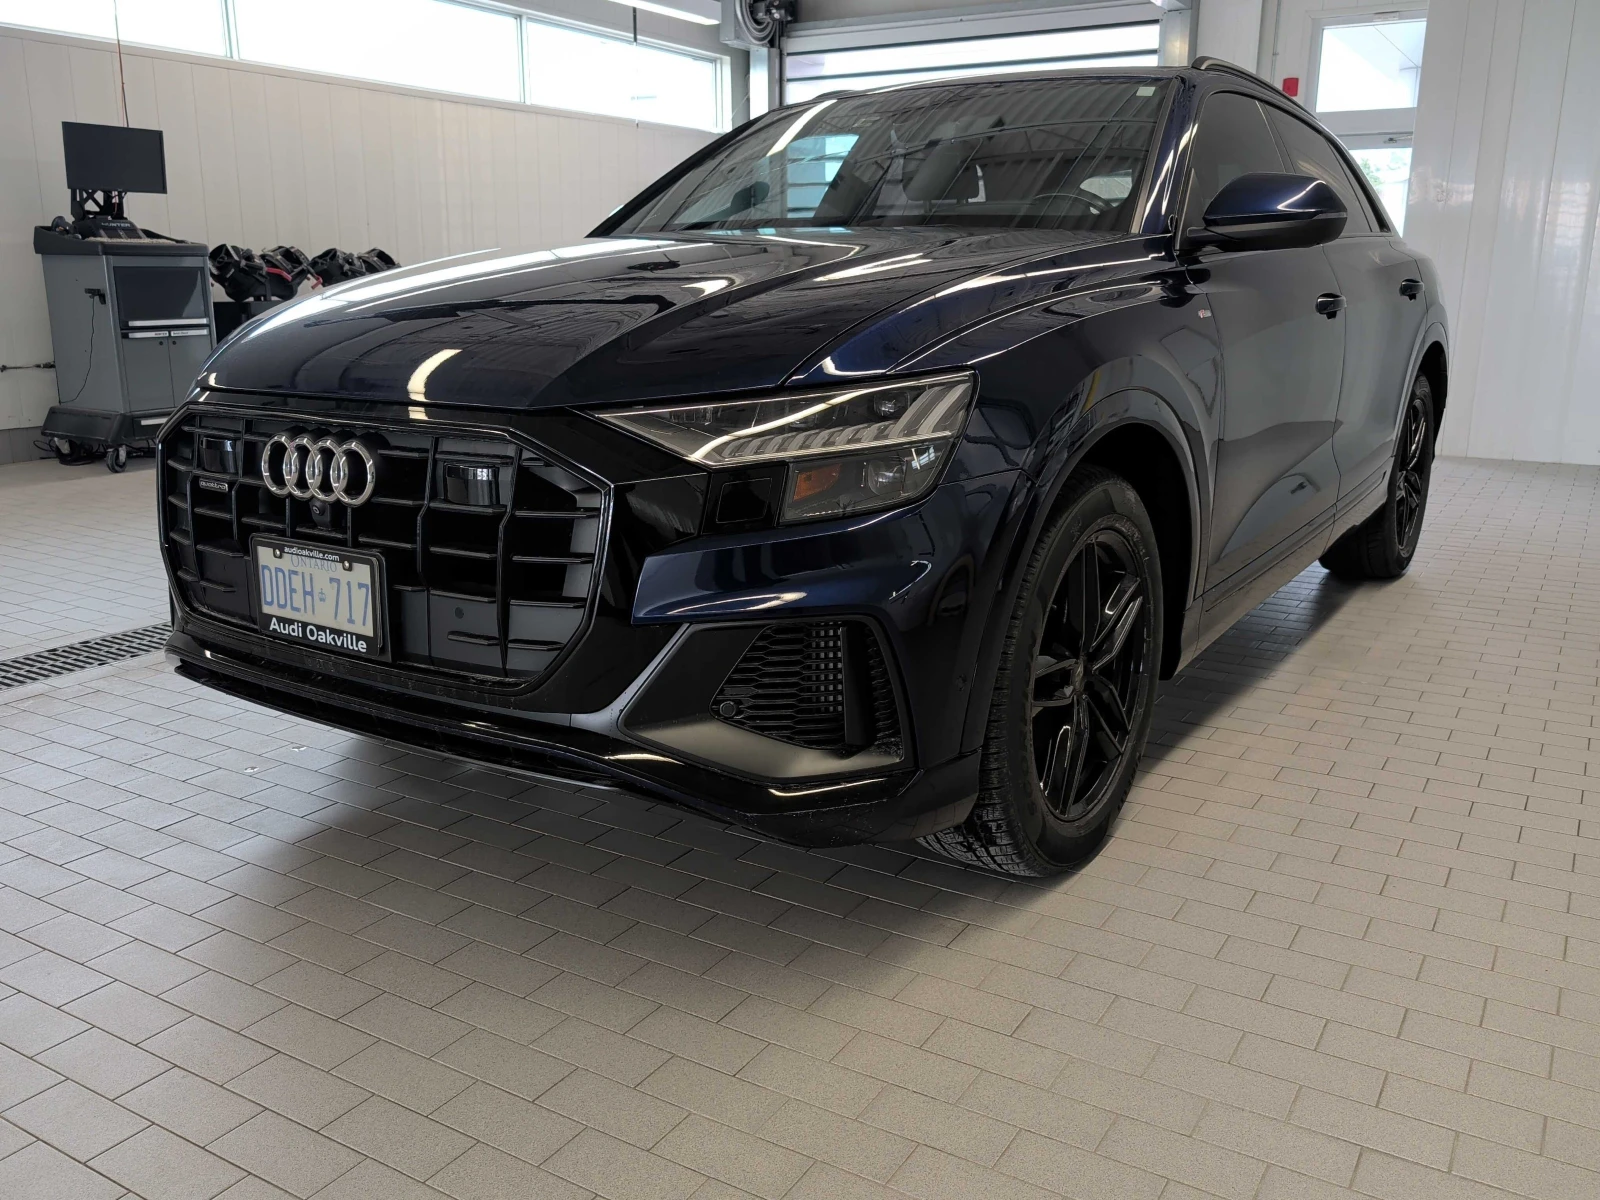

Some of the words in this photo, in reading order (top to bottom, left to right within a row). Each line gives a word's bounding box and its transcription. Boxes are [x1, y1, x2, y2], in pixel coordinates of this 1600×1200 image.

[284, 546, 340, 561] audioakville.com
[291, 555, 338, 572] ONTARIO
[261, 564, 315, 615] DDEH
[329, 577, 369, 627] 717
[269, 617, 302, 638] Audi
[306, 625, 367, 652] Oakville
